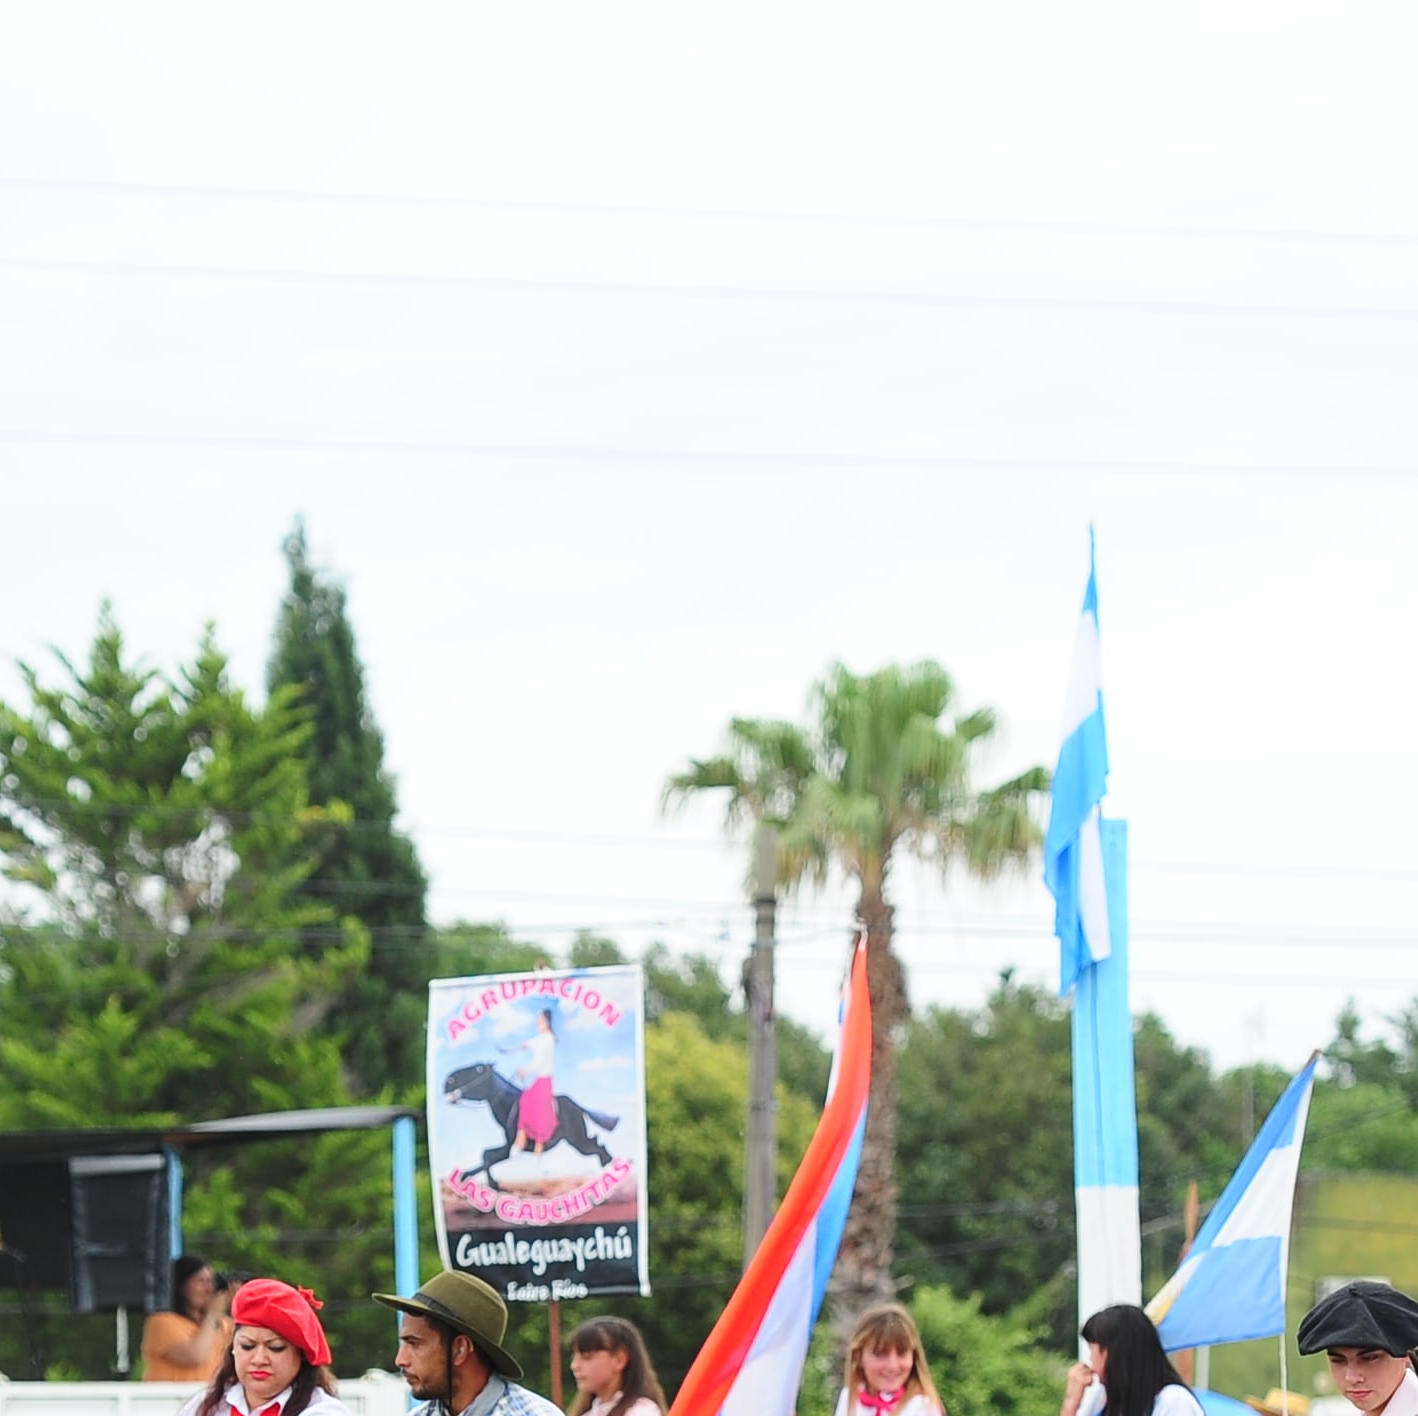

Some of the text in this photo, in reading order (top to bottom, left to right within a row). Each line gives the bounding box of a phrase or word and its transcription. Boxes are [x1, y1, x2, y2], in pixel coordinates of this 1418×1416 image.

[446, 977, 623, 1040] AGRUPACION
[447, 1157, 634, 1225] LAS GAUCHITAS
[455, 1225, 632, 1276] Gualeguaychú
